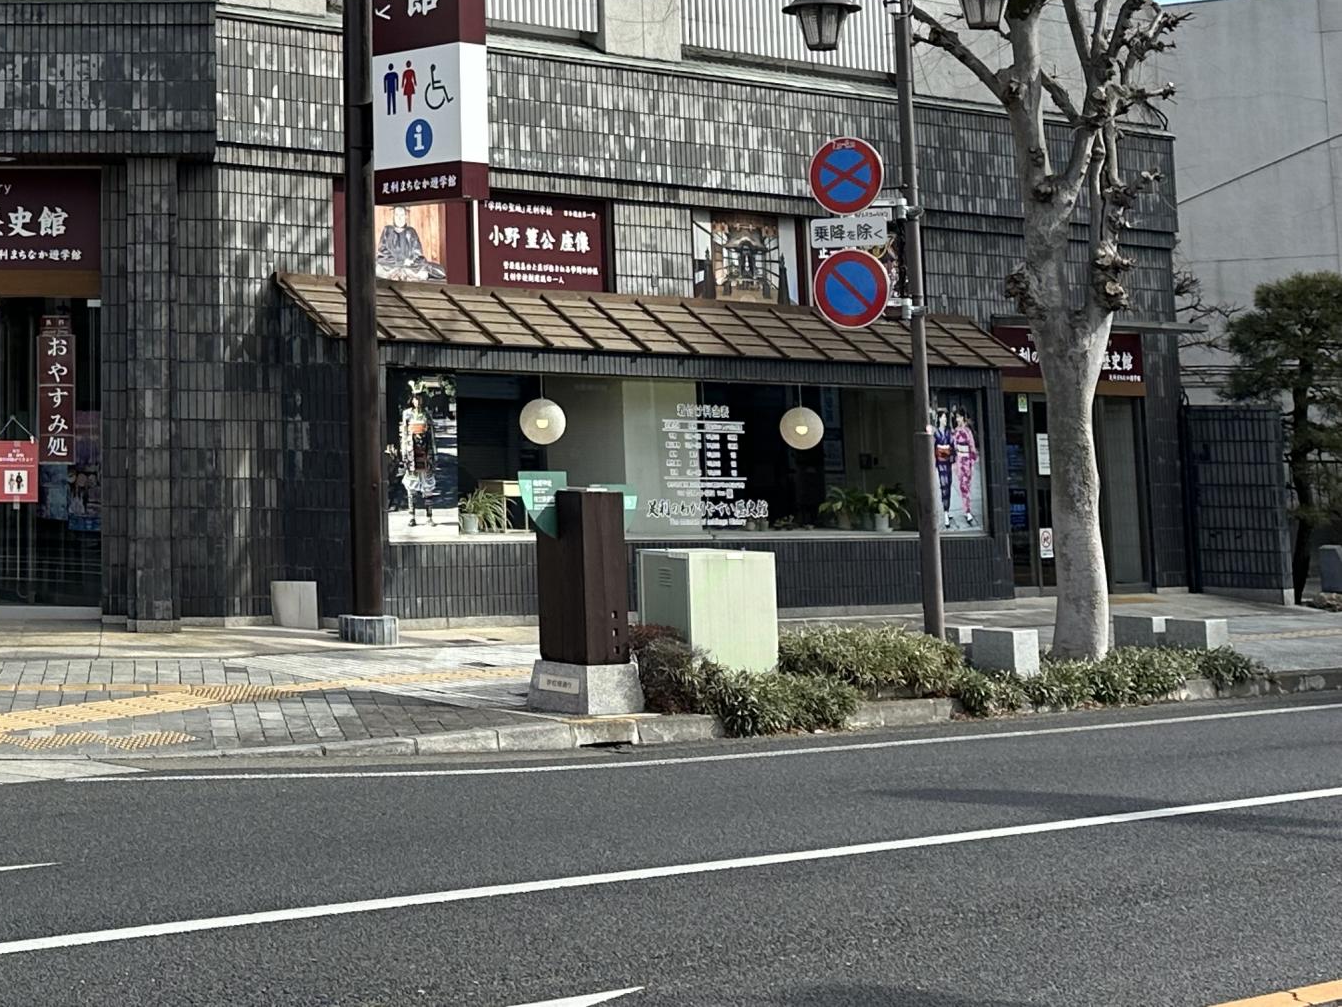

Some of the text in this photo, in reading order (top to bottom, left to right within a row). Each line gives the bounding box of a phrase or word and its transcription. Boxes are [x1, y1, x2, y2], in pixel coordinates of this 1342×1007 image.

[381, 174, 457, 195] 足利まちなか遊学館
[488, 224, 521, 249] 小野
[559, 230, 591, 254] 座像
[814, 223, 883, 242] 乗降を除く
[47, 336, 69, 457] おやすみ処
